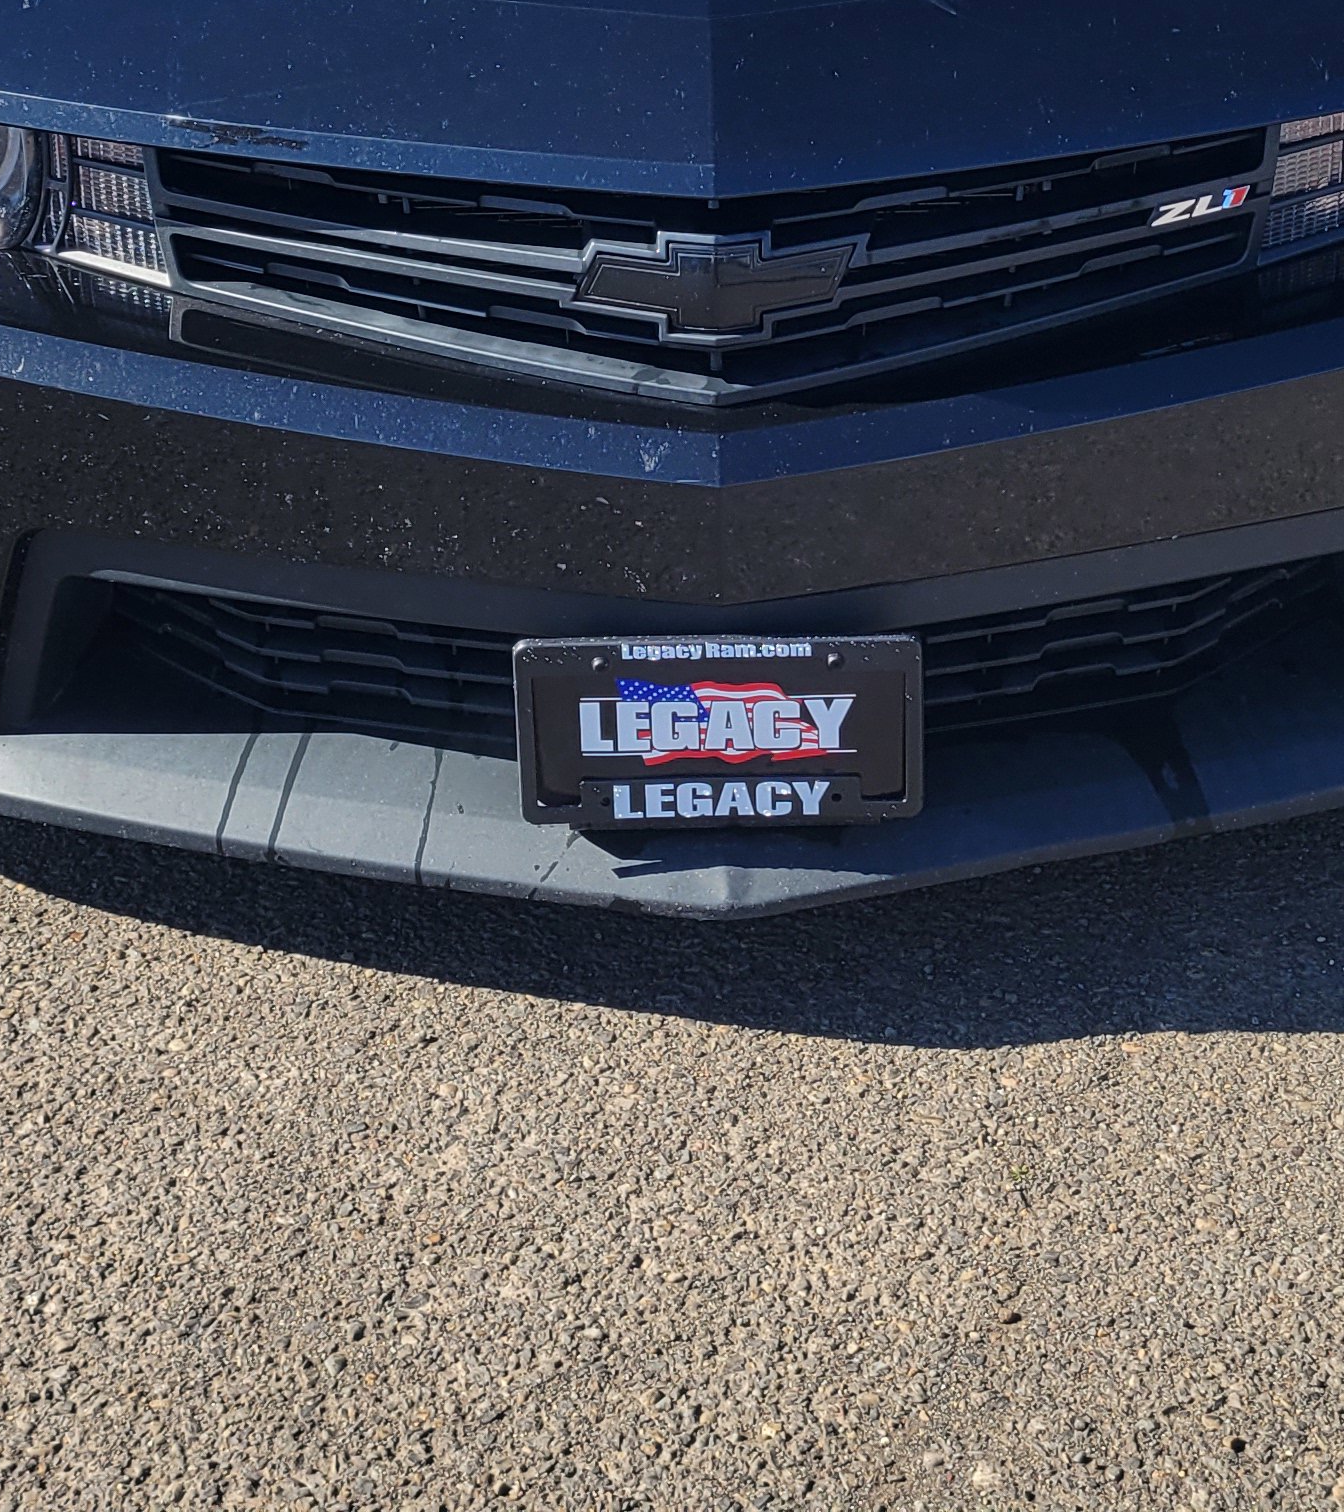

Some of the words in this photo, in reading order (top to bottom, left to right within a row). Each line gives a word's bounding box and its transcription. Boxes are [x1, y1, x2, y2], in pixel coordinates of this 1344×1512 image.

[1151, 185, 1250, 227] ZL1
[580, 699, 854, 752] LEGACY
[612, 781, 830, 820] LEGACY
